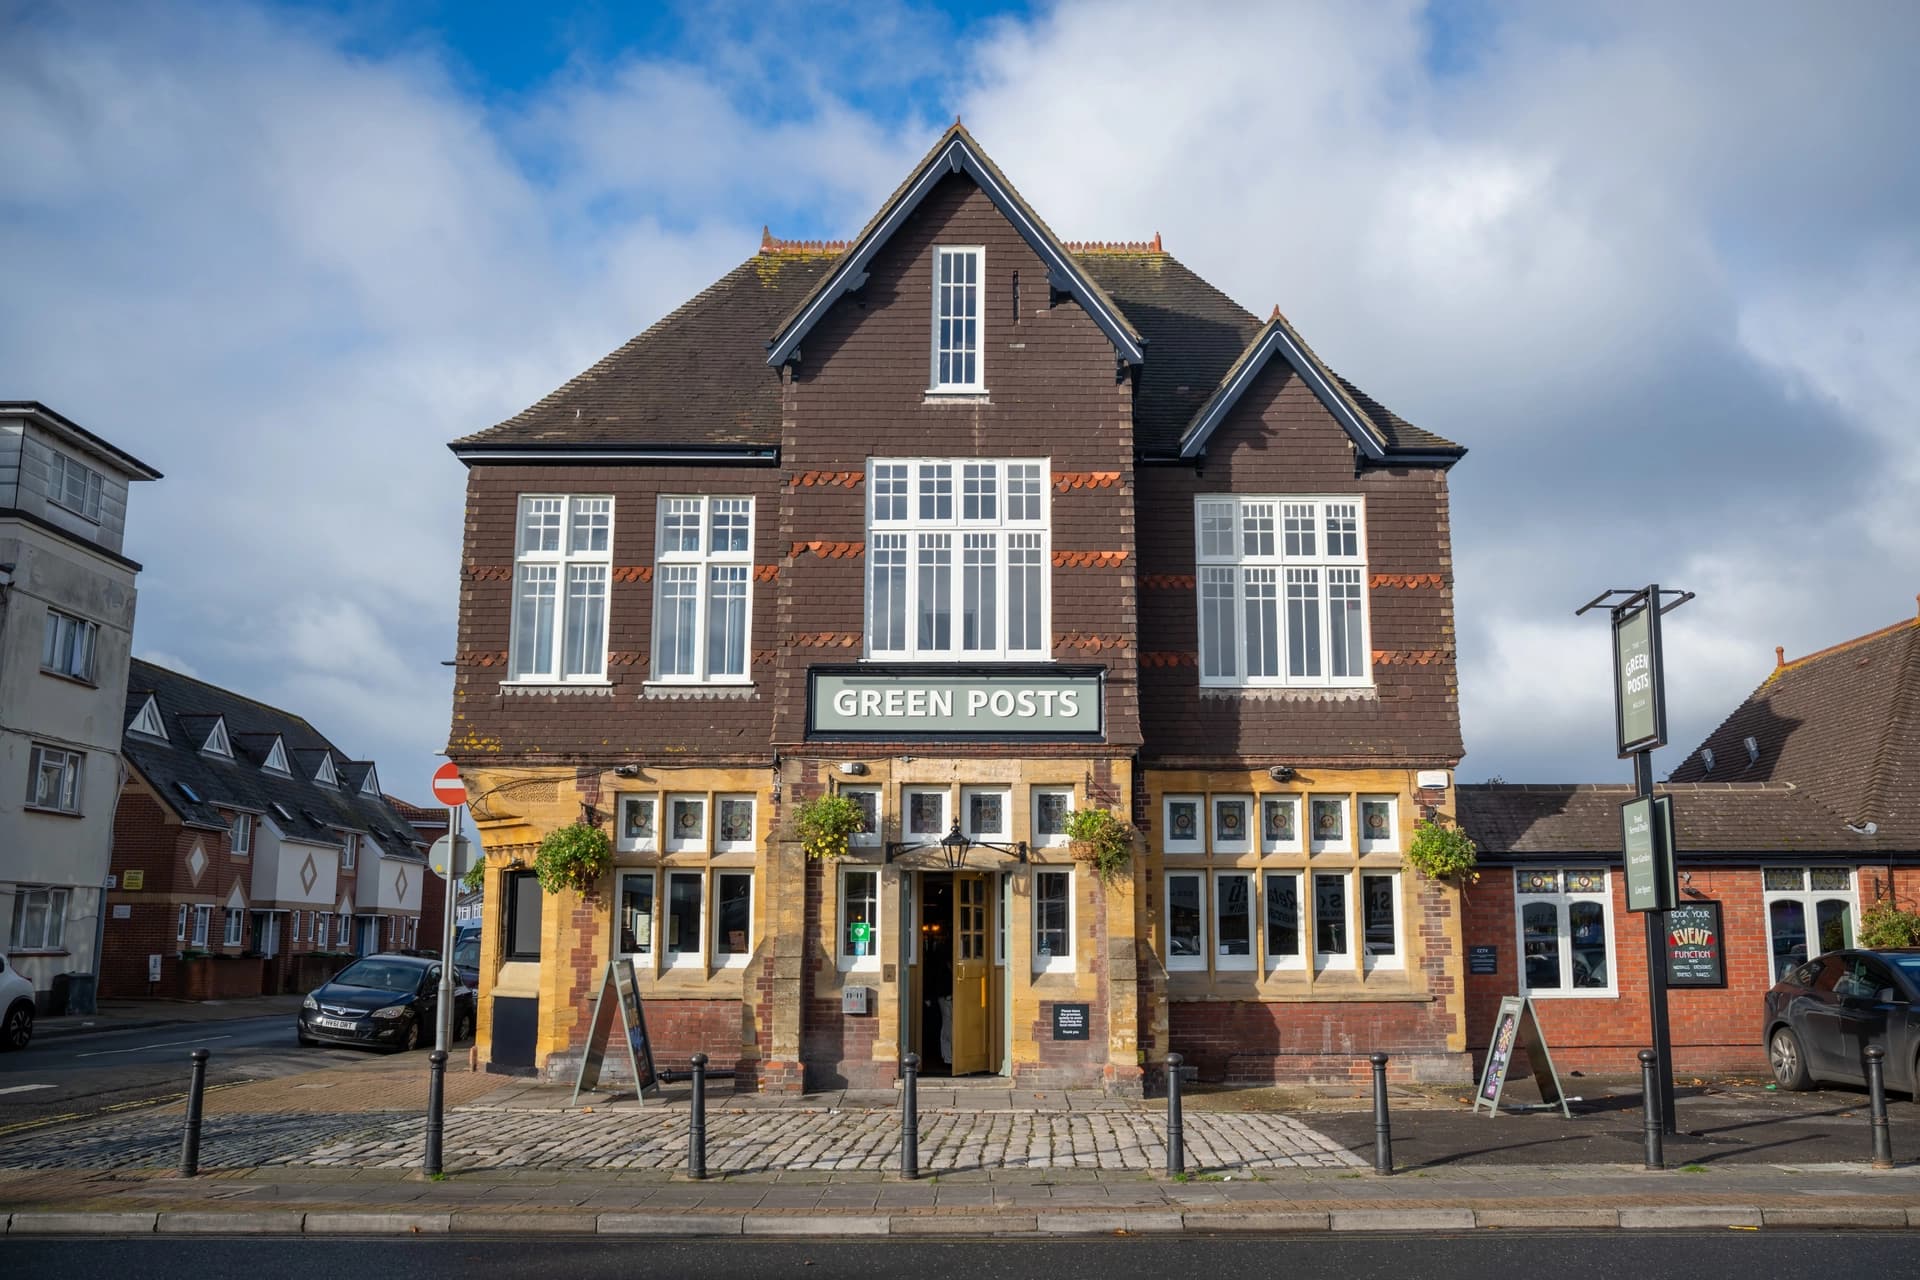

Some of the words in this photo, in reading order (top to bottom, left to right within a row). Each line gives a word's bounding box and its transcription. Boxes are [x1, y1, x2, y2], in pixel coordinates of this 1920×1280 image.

[1625, 654, 1649, 676] GREEN
[1627, 673, 1649, 695] POSTS
[833, 689, 953, 717] GREEN
[967, 689, 1080, 717] POSTS
[1692, 910, 1711, 918] YOUR
[1672, 927, 1713, 946] EVENT
[1674, 950, 1711, 958] FUNCTION
